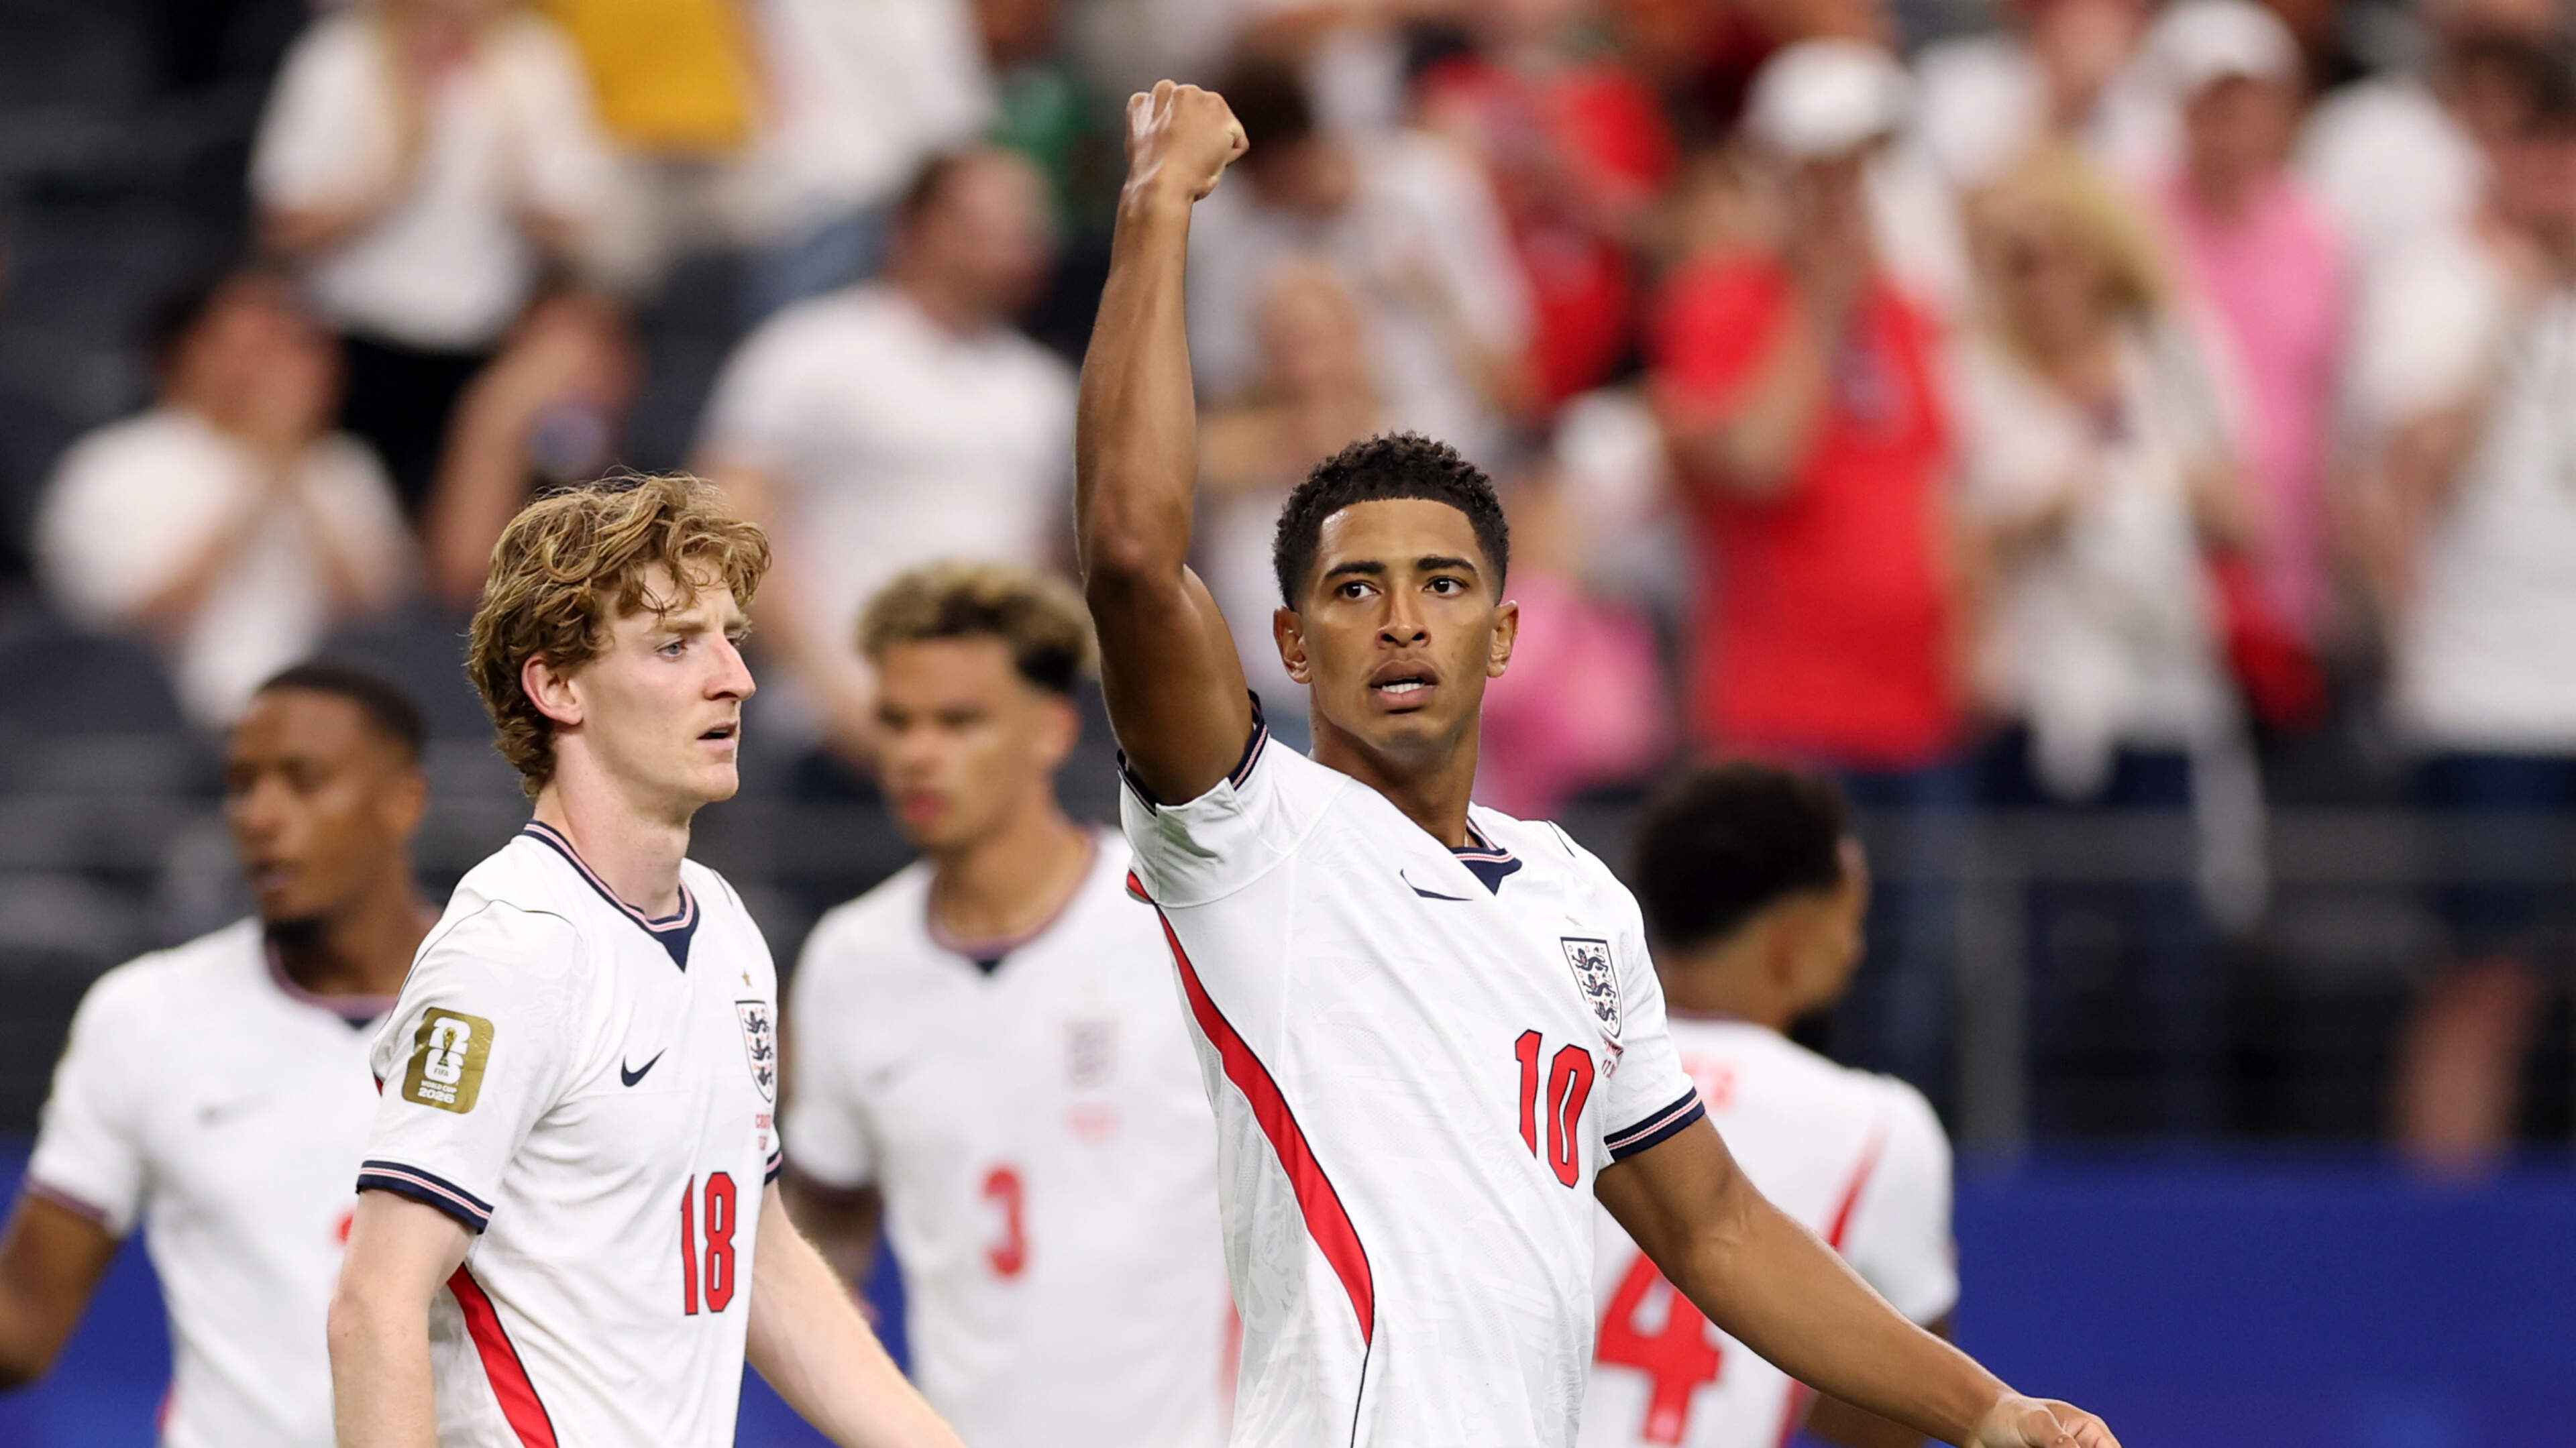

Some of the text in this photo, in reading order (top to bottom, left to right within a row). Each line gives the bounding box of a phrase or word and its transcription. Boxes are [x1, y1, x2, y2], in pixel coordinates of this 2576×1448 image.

[417, 1087, 456, 1105] 2026
[421, 1079, 458, 1094] WORLD CUP
[433, 1067, 449, 1077] FIFA
[1515, 1029, 1595, 1189] 10
[680, 1171, 737, 1316] 18
[981, 1166, 1030, 1277] 3
[1595, 1247, 1723, 1447] 4
